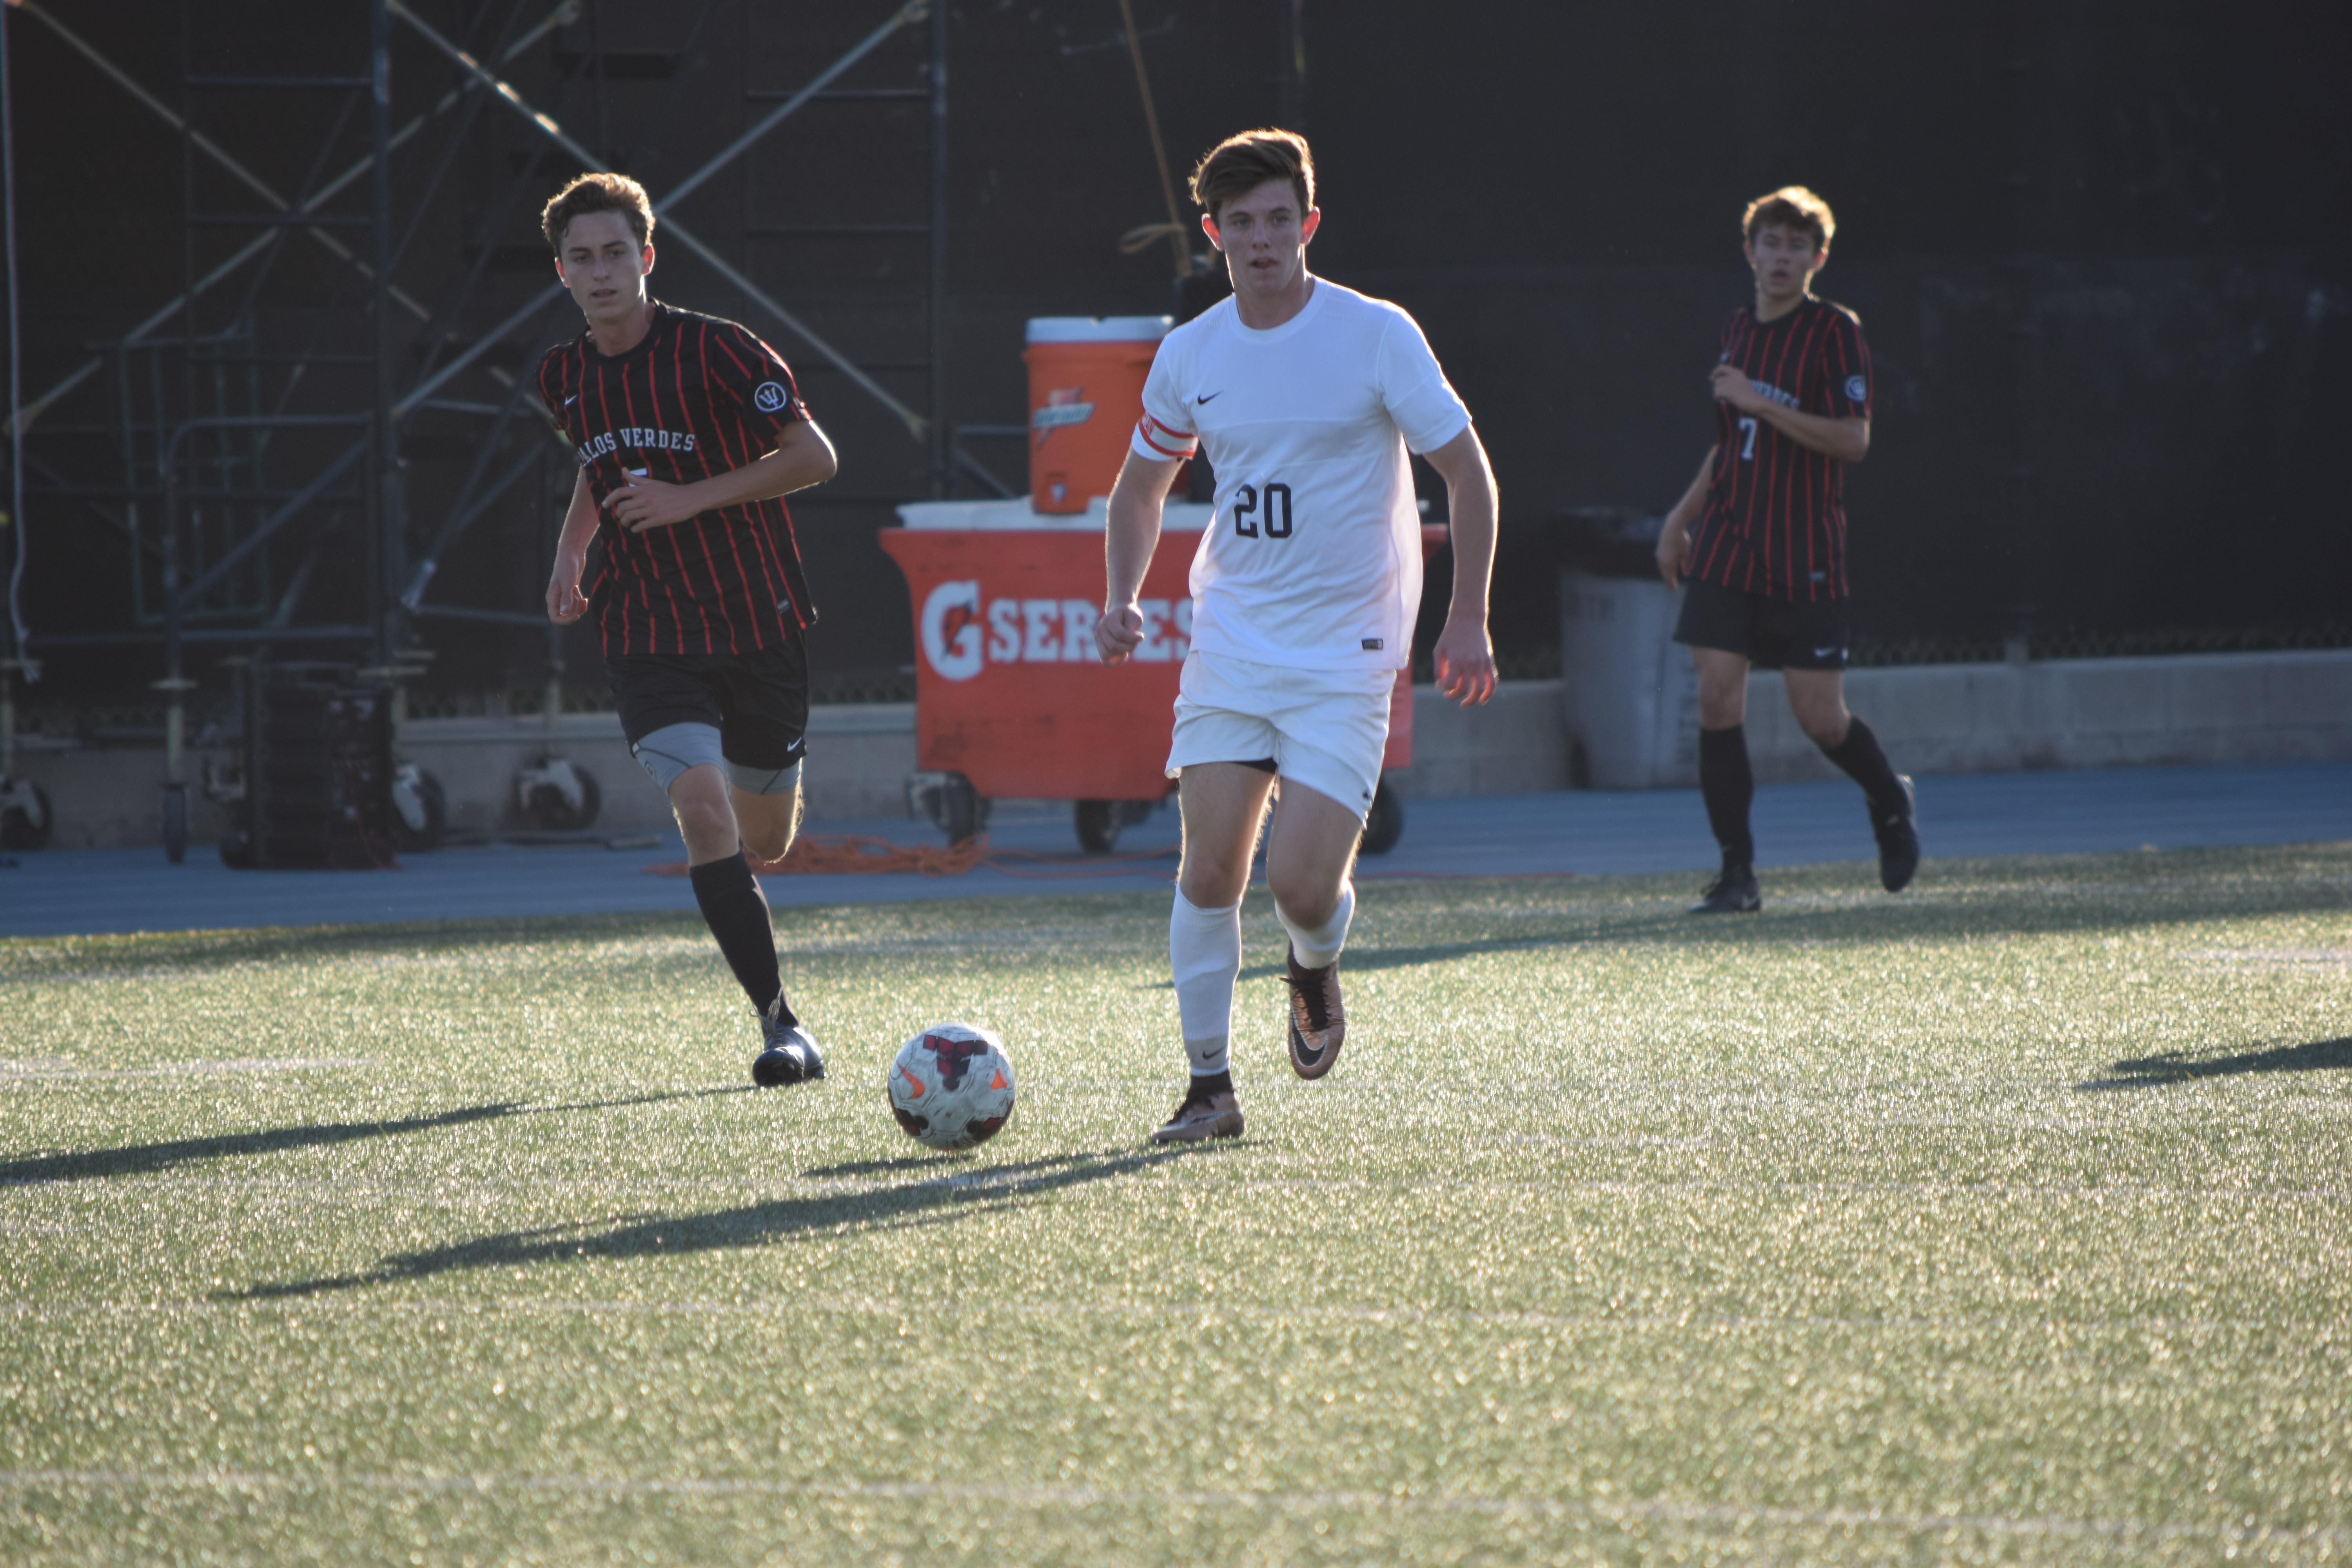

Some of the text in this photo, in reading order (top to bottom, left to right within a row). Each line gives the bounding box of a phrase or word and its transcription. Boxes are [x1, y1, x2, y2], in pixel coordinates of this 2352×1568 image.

[577, 428, 695, 468] ALOS VERDES
[1739, 417, 1757, 461] 7
[1233, 483, 1292, 539] 20
[921, 579, 983, 682] G
